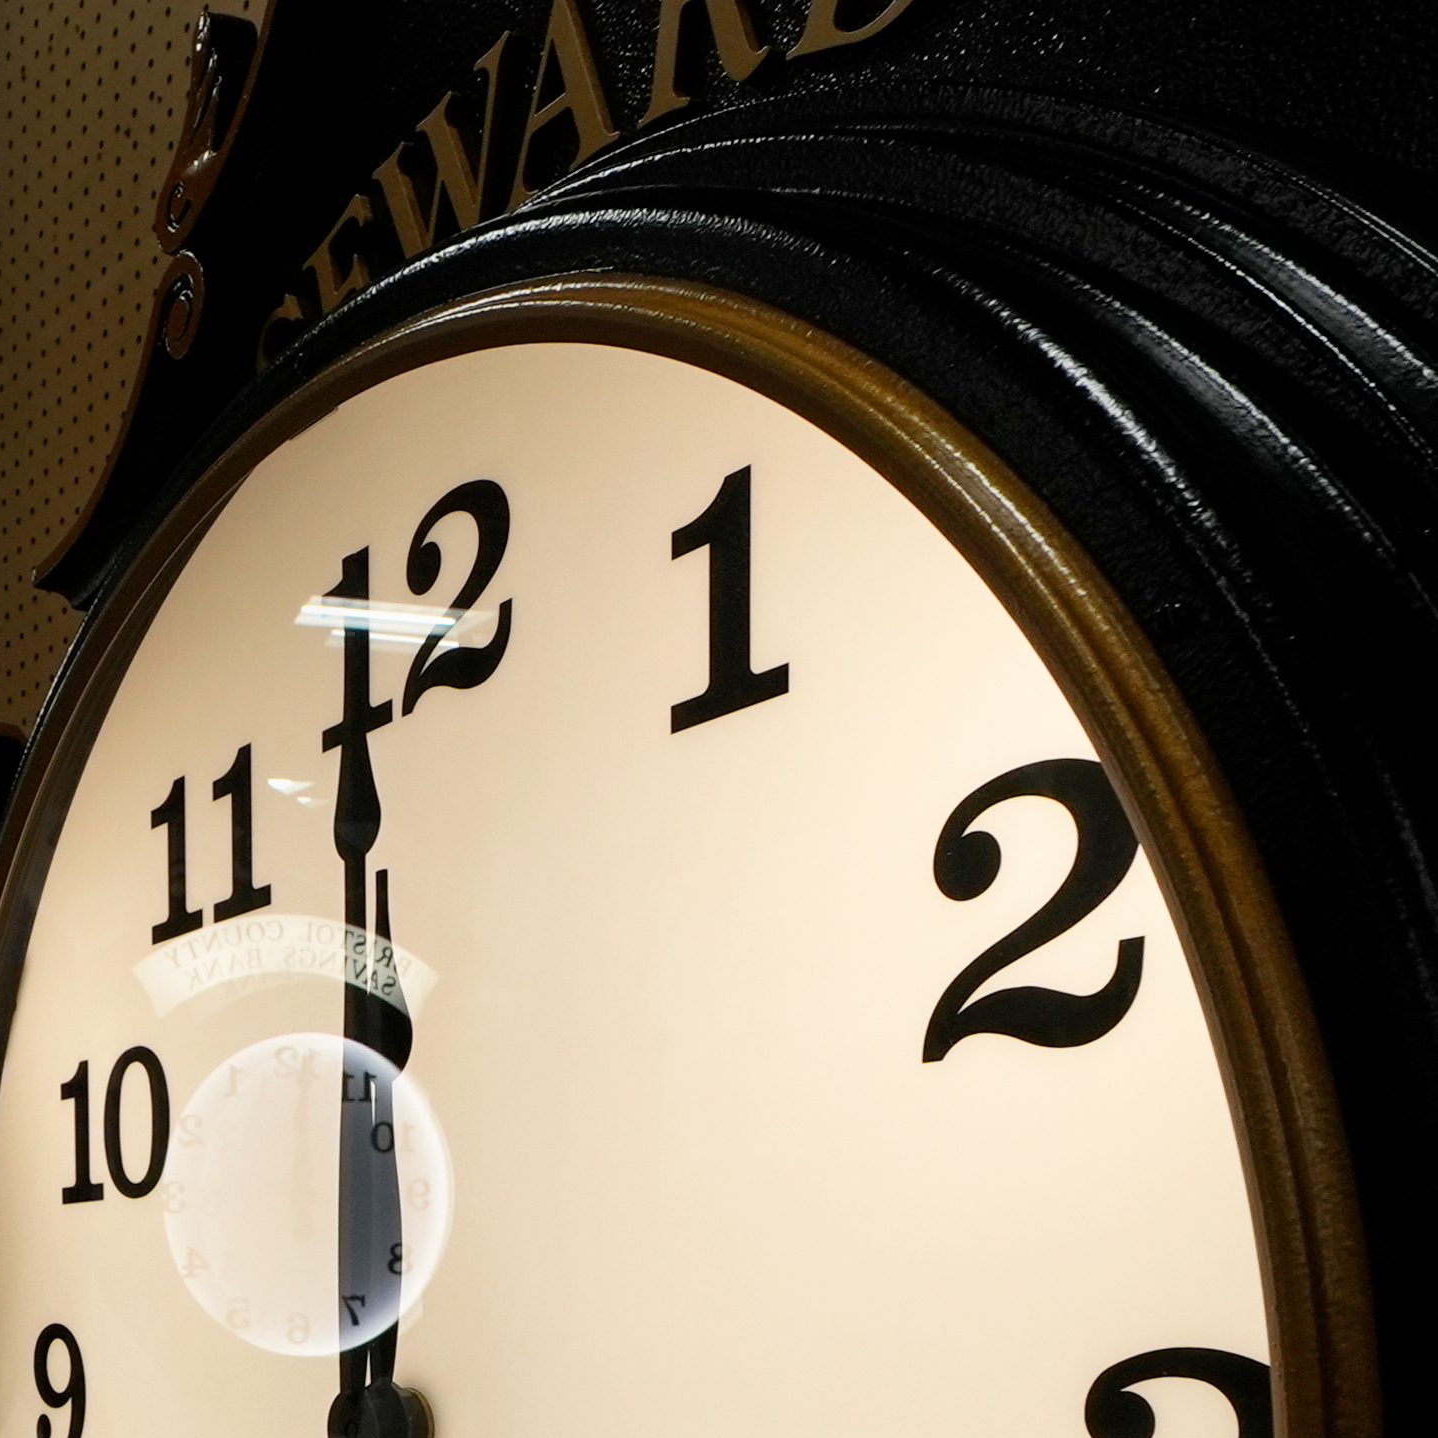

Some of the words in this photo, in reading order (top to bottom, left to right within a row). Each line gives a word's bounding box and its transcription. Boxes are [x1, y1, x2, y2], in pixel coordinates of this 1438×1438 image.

[255, 0, 918, 372] EWAR
[322, 480, 512, 754] 12
[671, 464, 789, 734] 1
[151, 743, 271, 945] 11
[923, 757, 1145, 1063] 2
[61, 1045, 170, 1205] 10
